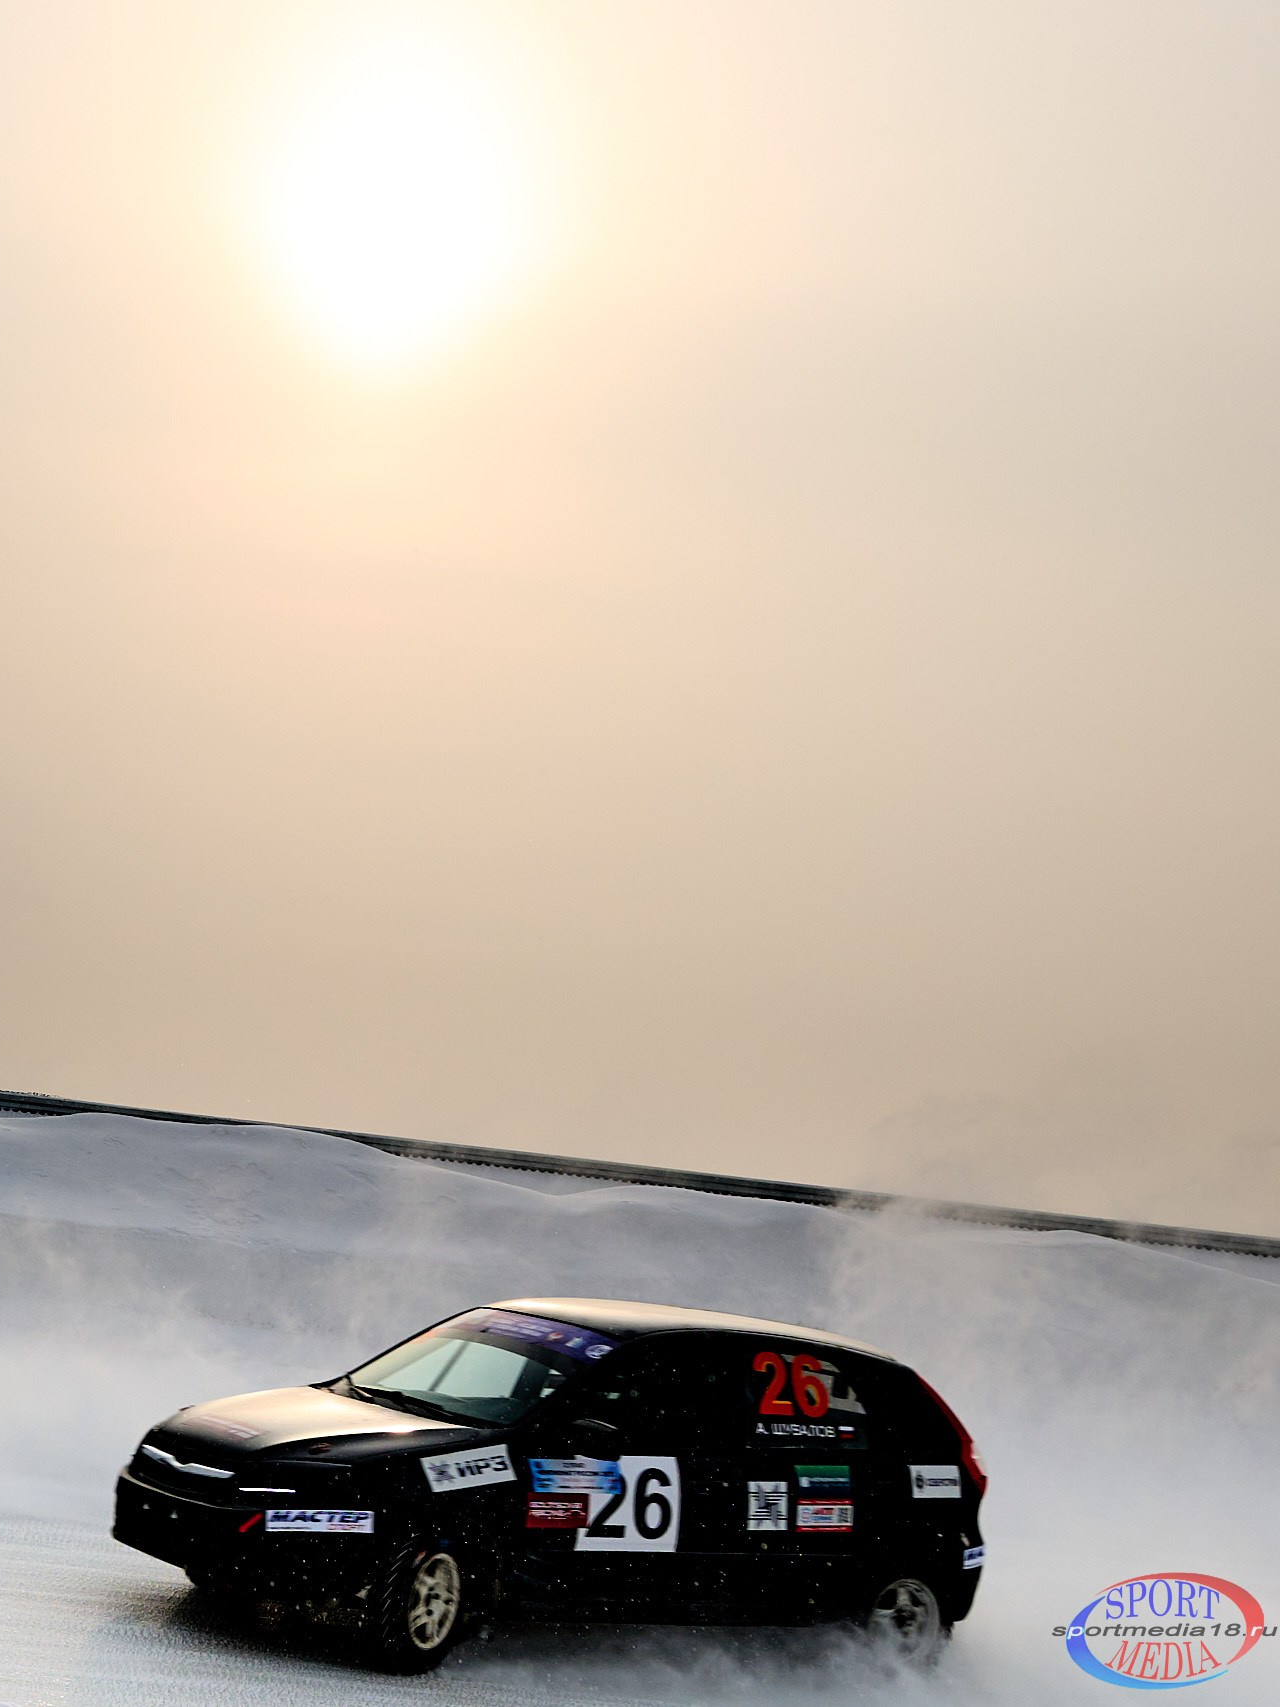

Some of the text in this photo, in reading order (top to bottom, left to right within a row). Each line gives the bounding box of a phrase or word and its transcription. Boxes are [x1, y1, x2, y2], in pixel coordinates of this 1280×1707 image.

[752, 1351, 830, 1418] 26
[455, 1455, 508, 1478] ИРЗ
[270, 1510, 369, 1523] МАСТЕР
[585, 1467, 672, 1540] 26
